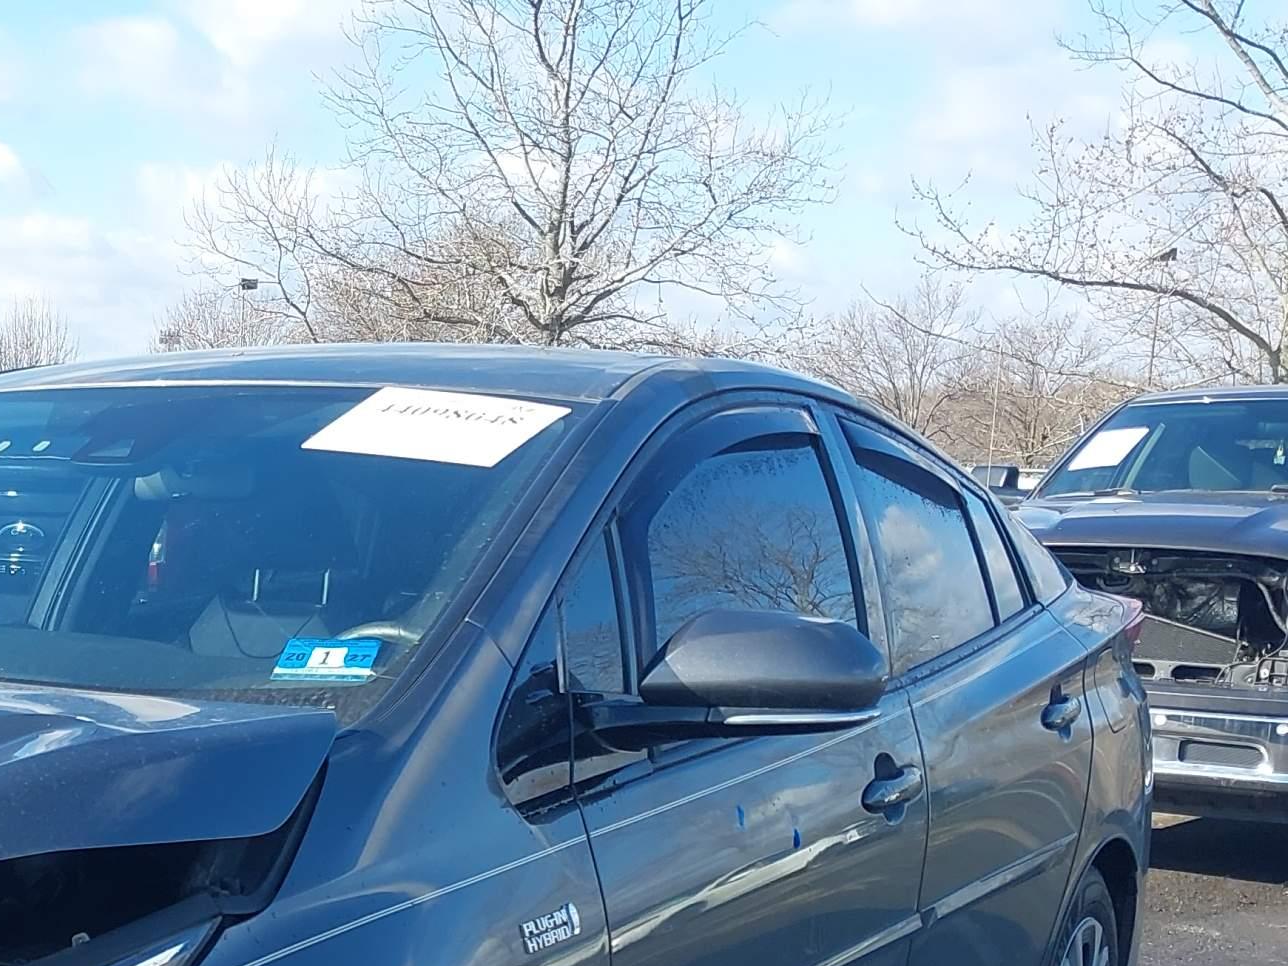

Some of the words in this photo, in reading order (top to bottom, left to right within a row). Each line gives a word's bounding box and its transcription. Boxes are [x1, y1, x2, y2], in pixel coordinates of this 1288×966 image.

[285, 652, 307, 662] 20
[317, 650, 332, 666] 1
[524, 926, 571, 953] HYBRID
